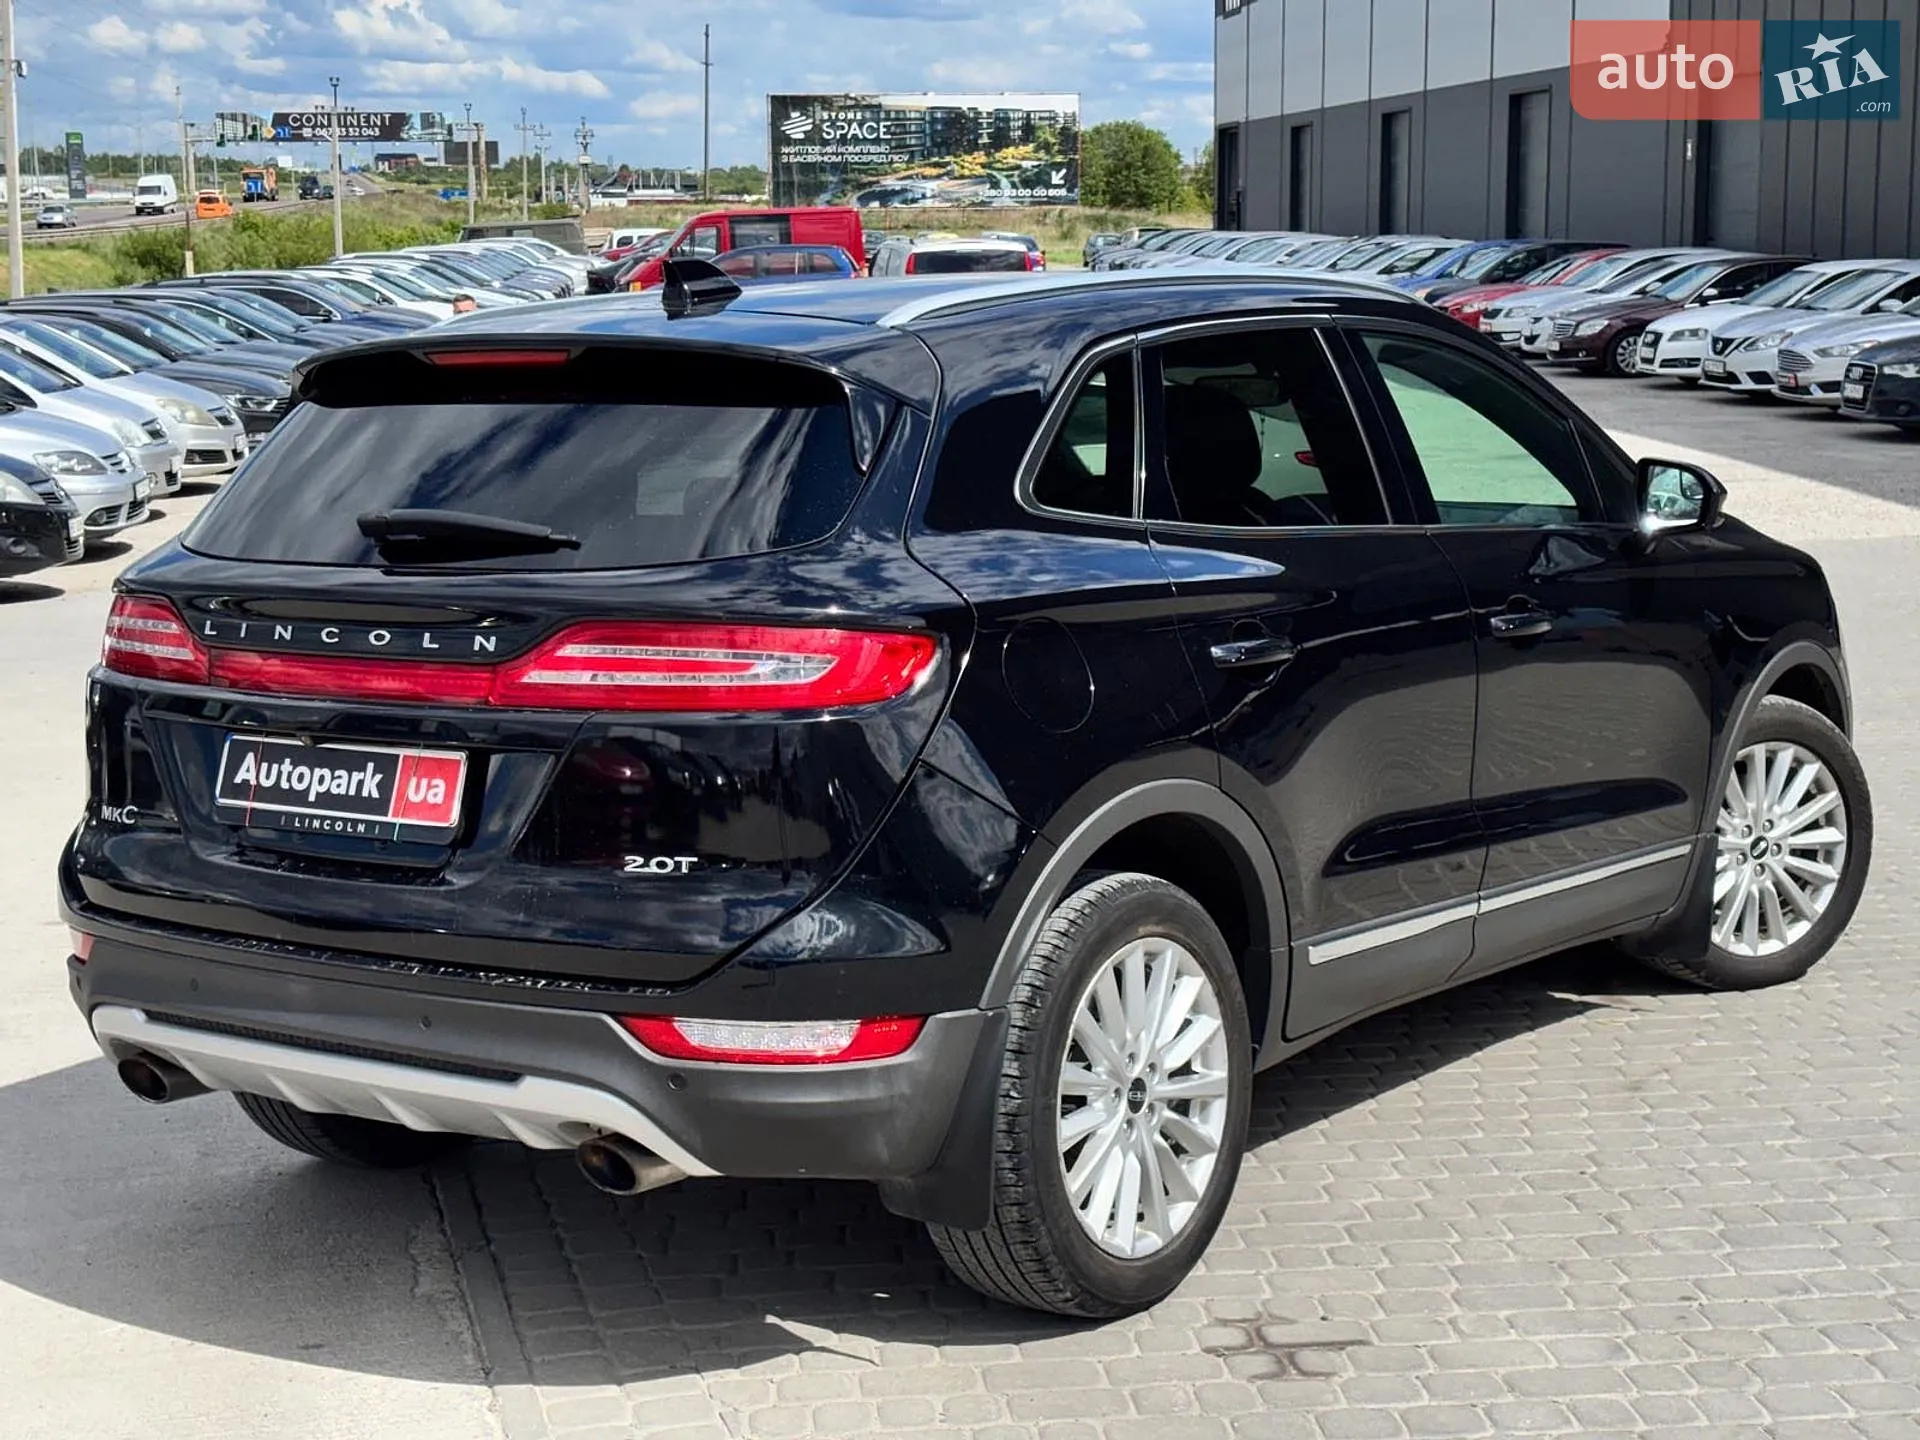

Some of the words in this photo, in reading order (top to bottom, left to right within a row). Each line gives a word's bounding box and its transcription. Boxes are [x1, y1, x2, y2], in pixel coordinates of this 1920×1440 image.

[289, 113, 392, 126] CONINENT
[822, 111, 862, 120] STONE
[349, 127, 360, 136] 32
[361, 127, 380, 136] 043
[822, 121, 892, 140] SPACE
[204, 619, 497, 652] LINCOLN
[233, 751, 384, 802] Autopark
[407, 775, 446, 805] ua
[100, 804, 139, 825] MKC
[294, 815, 366, 834] LINCOLN
